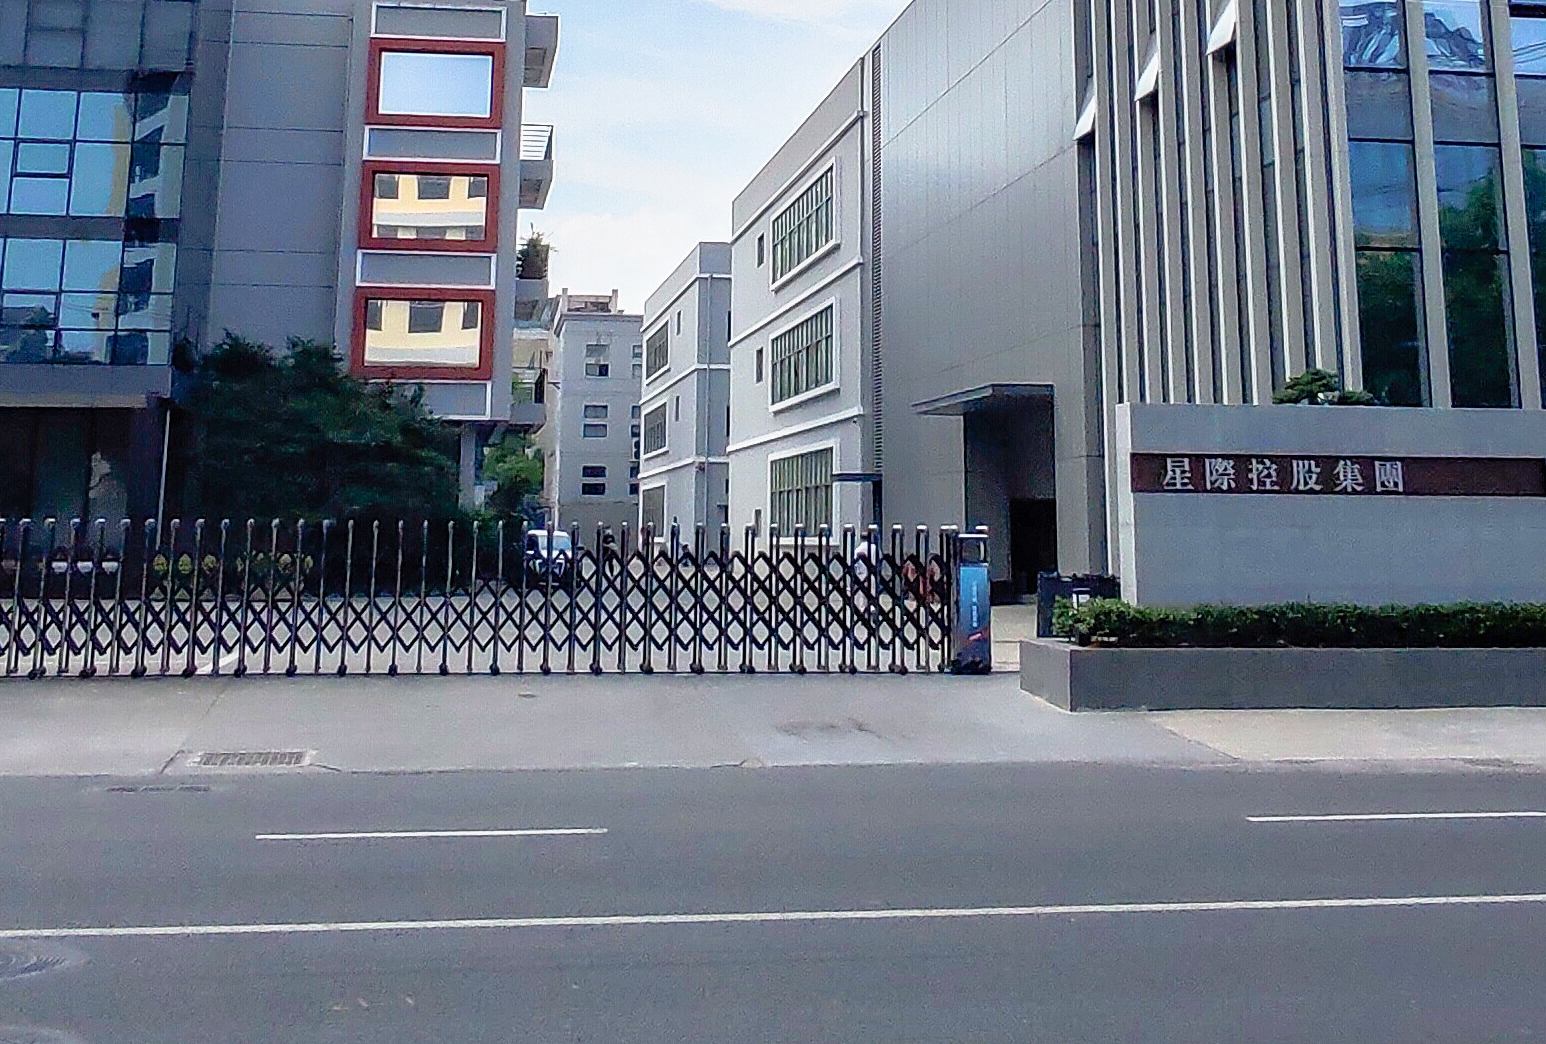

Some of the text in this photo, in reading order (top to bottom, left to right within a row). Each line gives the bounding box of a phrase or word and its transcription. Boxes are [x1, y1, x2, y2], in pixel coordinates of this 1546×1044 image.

[1162, 457, 1405, 493] 星際控股集團
